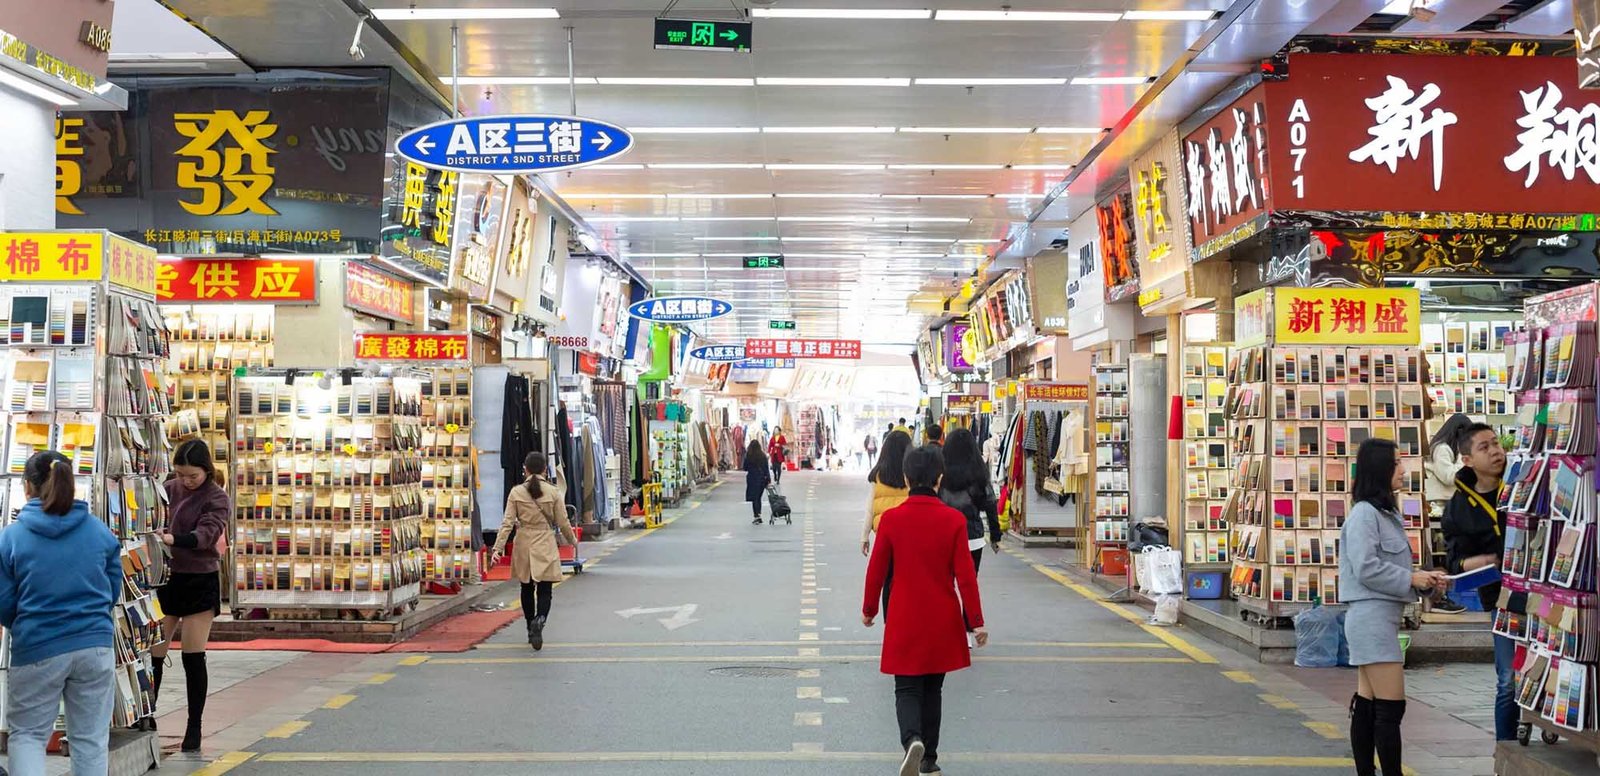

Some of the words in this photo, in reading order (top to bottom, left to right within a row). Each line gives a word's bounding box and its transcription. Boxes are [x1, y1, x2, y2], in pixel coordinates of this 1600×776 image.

[446, 121, 582, 155] A区三街
[1288, 98, 1311, 199] A071
[447, 155, 498, 165] DISTRICT
[502, 155, 509, 164] A
[513, 155, 534, 164] 3ND
[539, 154, 581, 163] STREET
[5, 239, 92, 275] 棉布
[651, 299, 713, 315] A区四街
[1288, 297, 1409, 334] 新翔盛
[358, 336, 467, 358] 廣發棉布
[704, 347, 745, 358] A区五街
